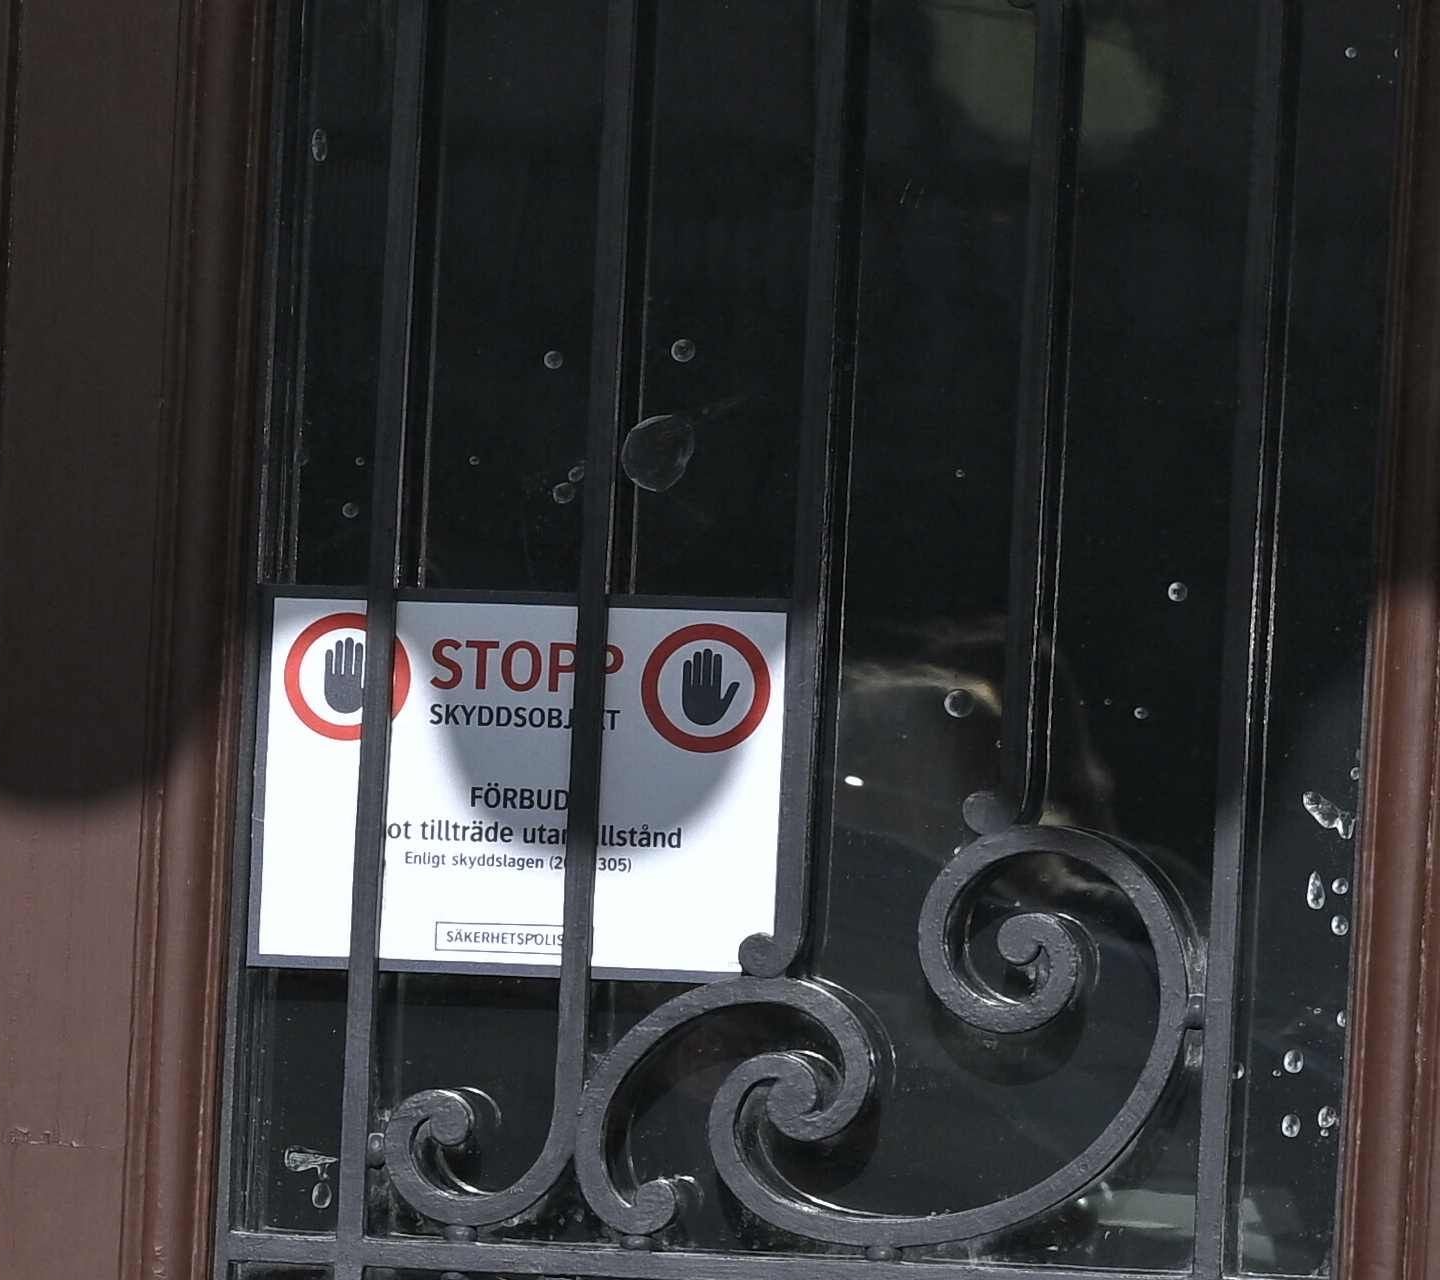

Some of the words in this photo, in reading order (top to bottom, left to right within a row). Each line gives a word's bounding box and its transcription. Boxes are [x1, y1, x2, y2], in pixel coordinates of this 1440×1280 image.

[430, 703, 621, 730] SKYDDSOBJT
[471, 782, 569, 810] FÖRBUD
[387, 820, 412, 839] ot
[421, 819, 514, 843] tillträde
[601, 824, 682, 849] llstånd
[405, 851, 446, 868] Enligt
[451, 852, 544, 871] skyddslagen
[549, 855, 632, 873] (2305)
[447, 928, 563, 946] SÄKERHETSPOLIS
